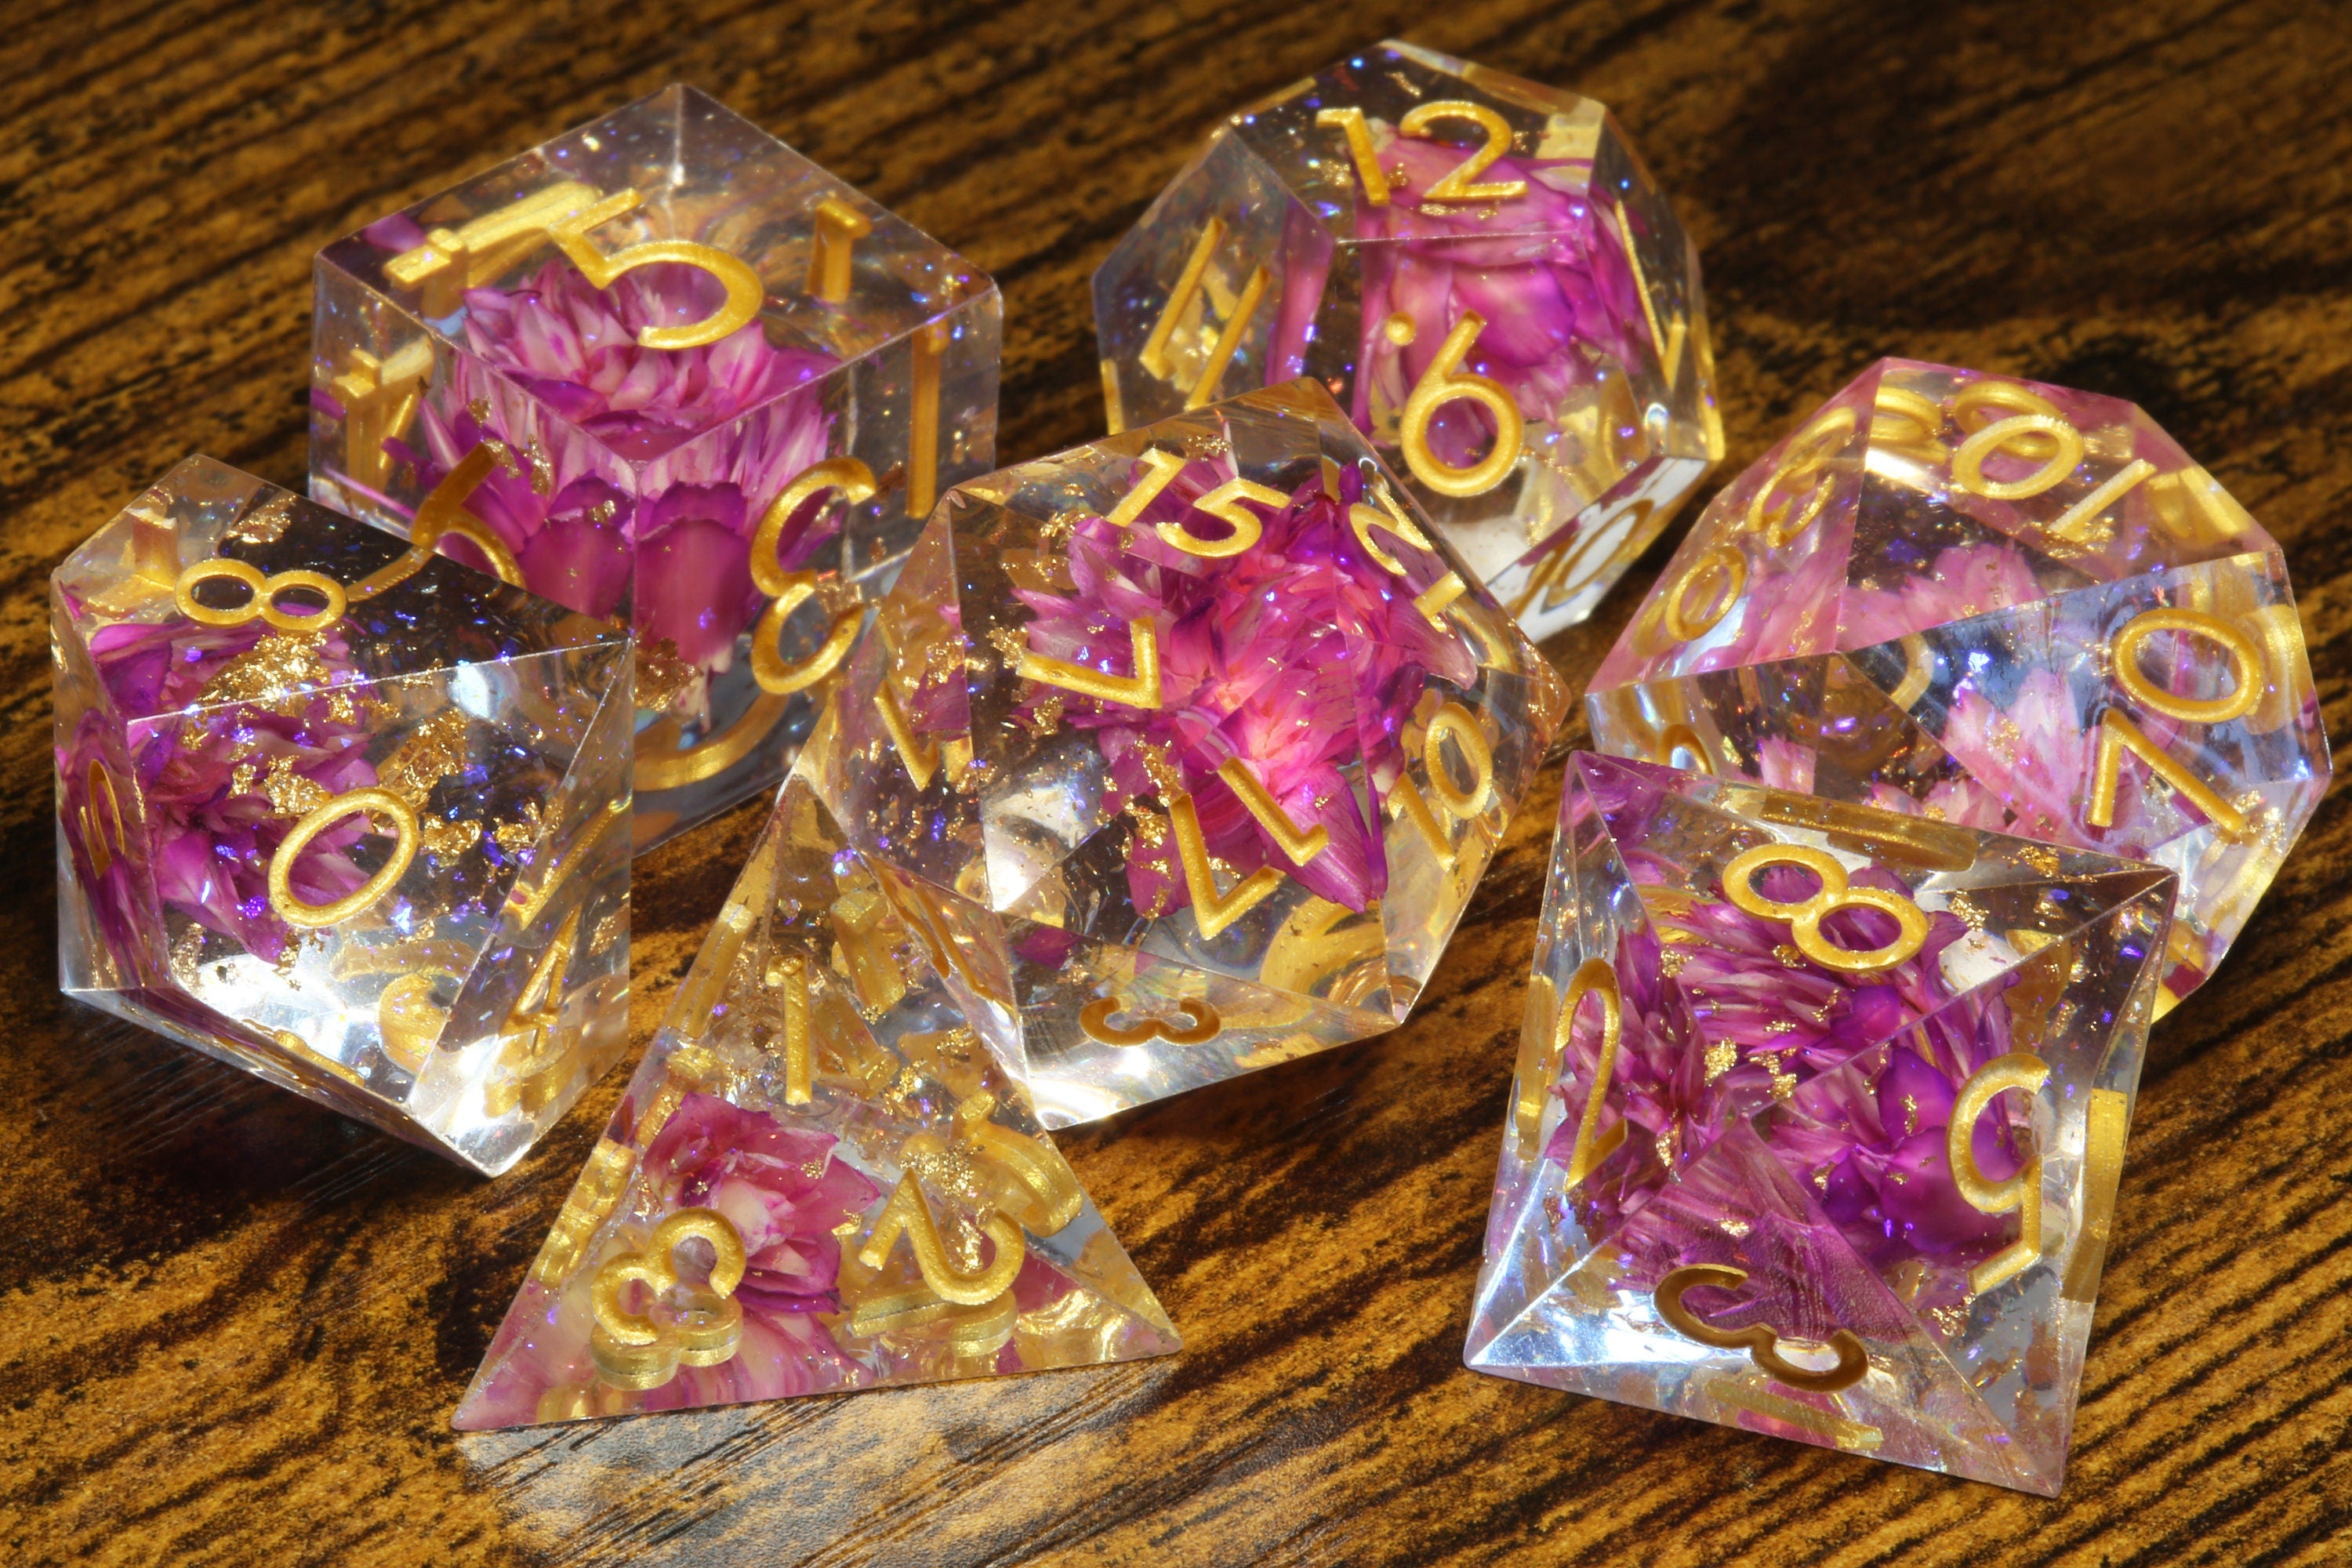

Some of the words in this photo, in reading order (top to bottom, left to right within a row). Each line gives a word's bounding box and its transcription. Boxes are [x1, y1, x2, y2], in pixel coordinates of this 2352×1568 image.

[1316, 100, 1527, 206] 12
[546, 188, 764, 350] 5
[1107, 447, 1294, 559] 15
[175, 557, 347, 628] 8
[750, 457, 877, 694] 3
[268, 787, 419, 928] 0
[1723, 844, 1928, 972] 8
[1080, 996, 1221, 1047] 3
[1555, 957, 1628, 1192] 2
[1653, 1263, 1869, 1393] 3
